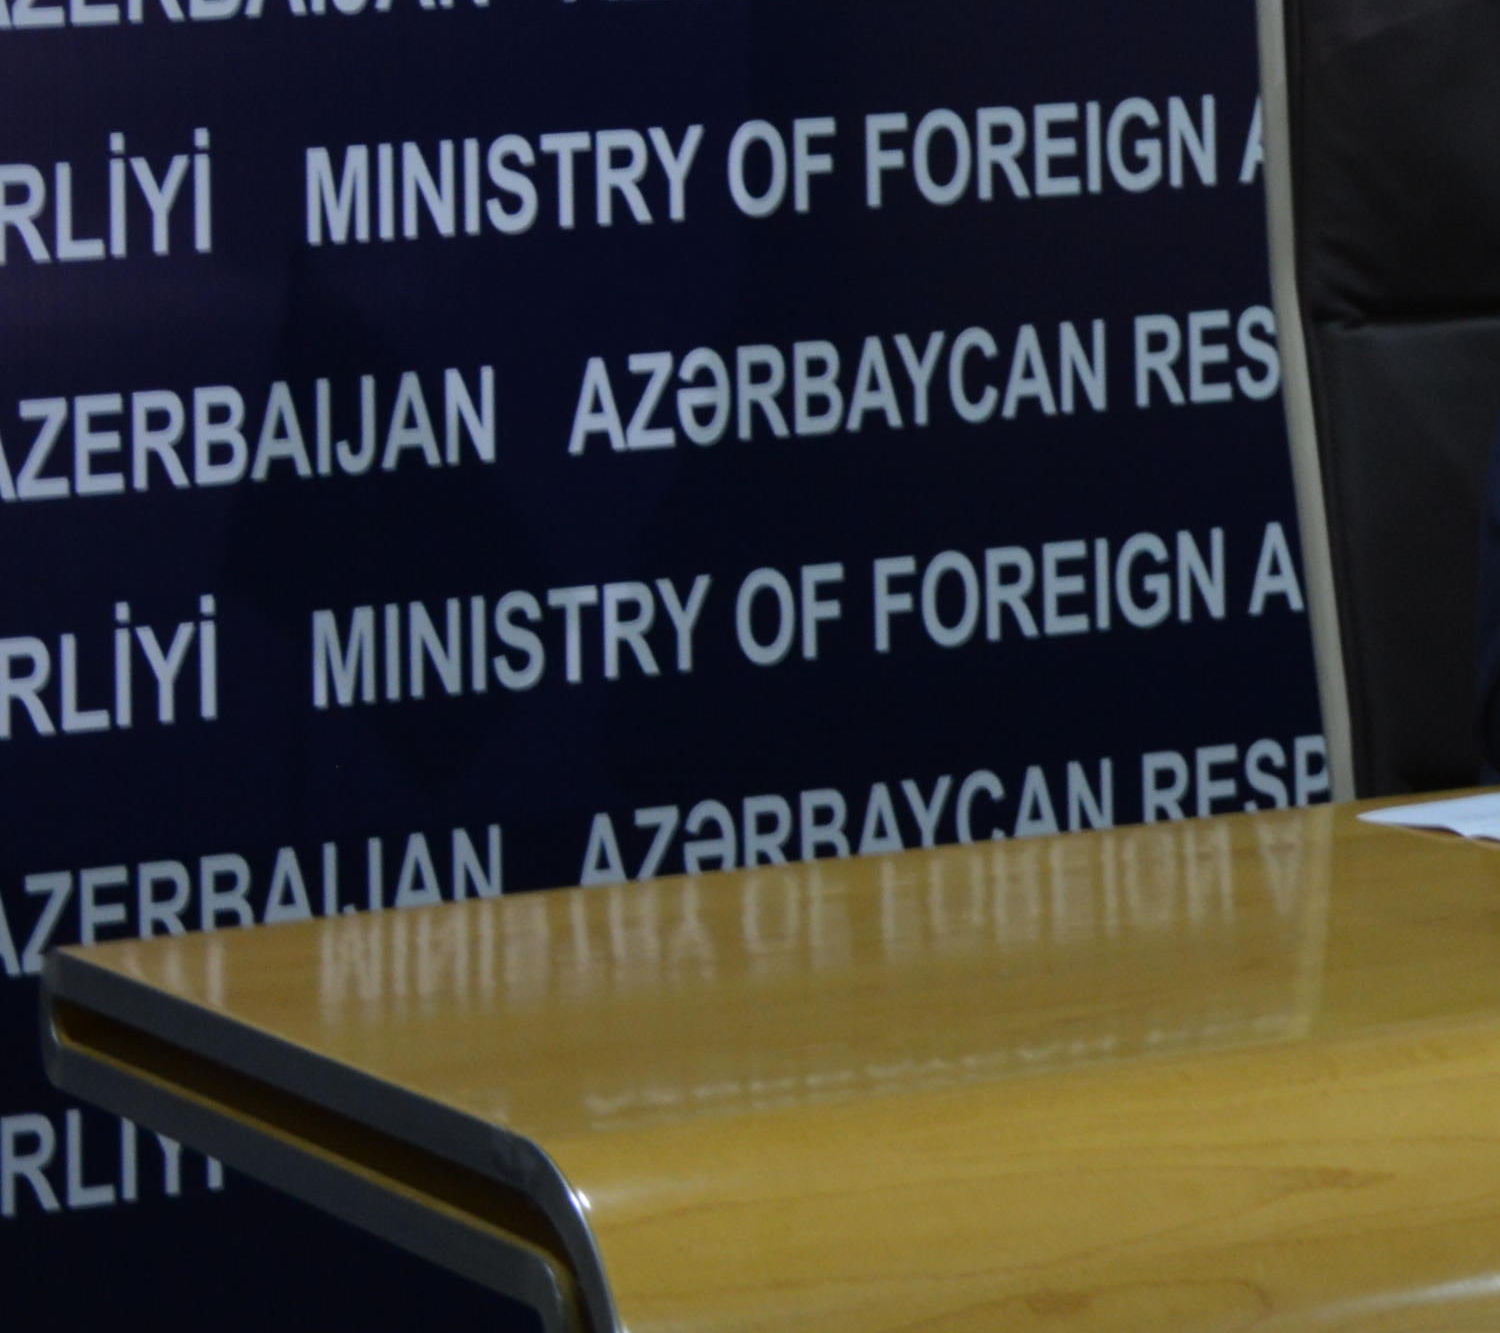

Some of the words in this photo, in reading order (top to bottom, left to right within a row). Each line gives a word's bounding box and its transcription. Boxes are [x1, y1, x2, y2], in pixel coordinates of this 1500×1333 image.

[306, 124, 705, 246] MINISTRY
[727, 116, 836, 218] OF
[865, 94, 1217, 209] FOREIGN
[568, 318, 1107, 456] AZƏRBAYCAN
[0, 594, 218, 740] RLİYİ
[312, 574, 712, 709] MINISTRY
[735, 562, 844, 666] OF
[873, 527, 1226, 653] FOREIGN
